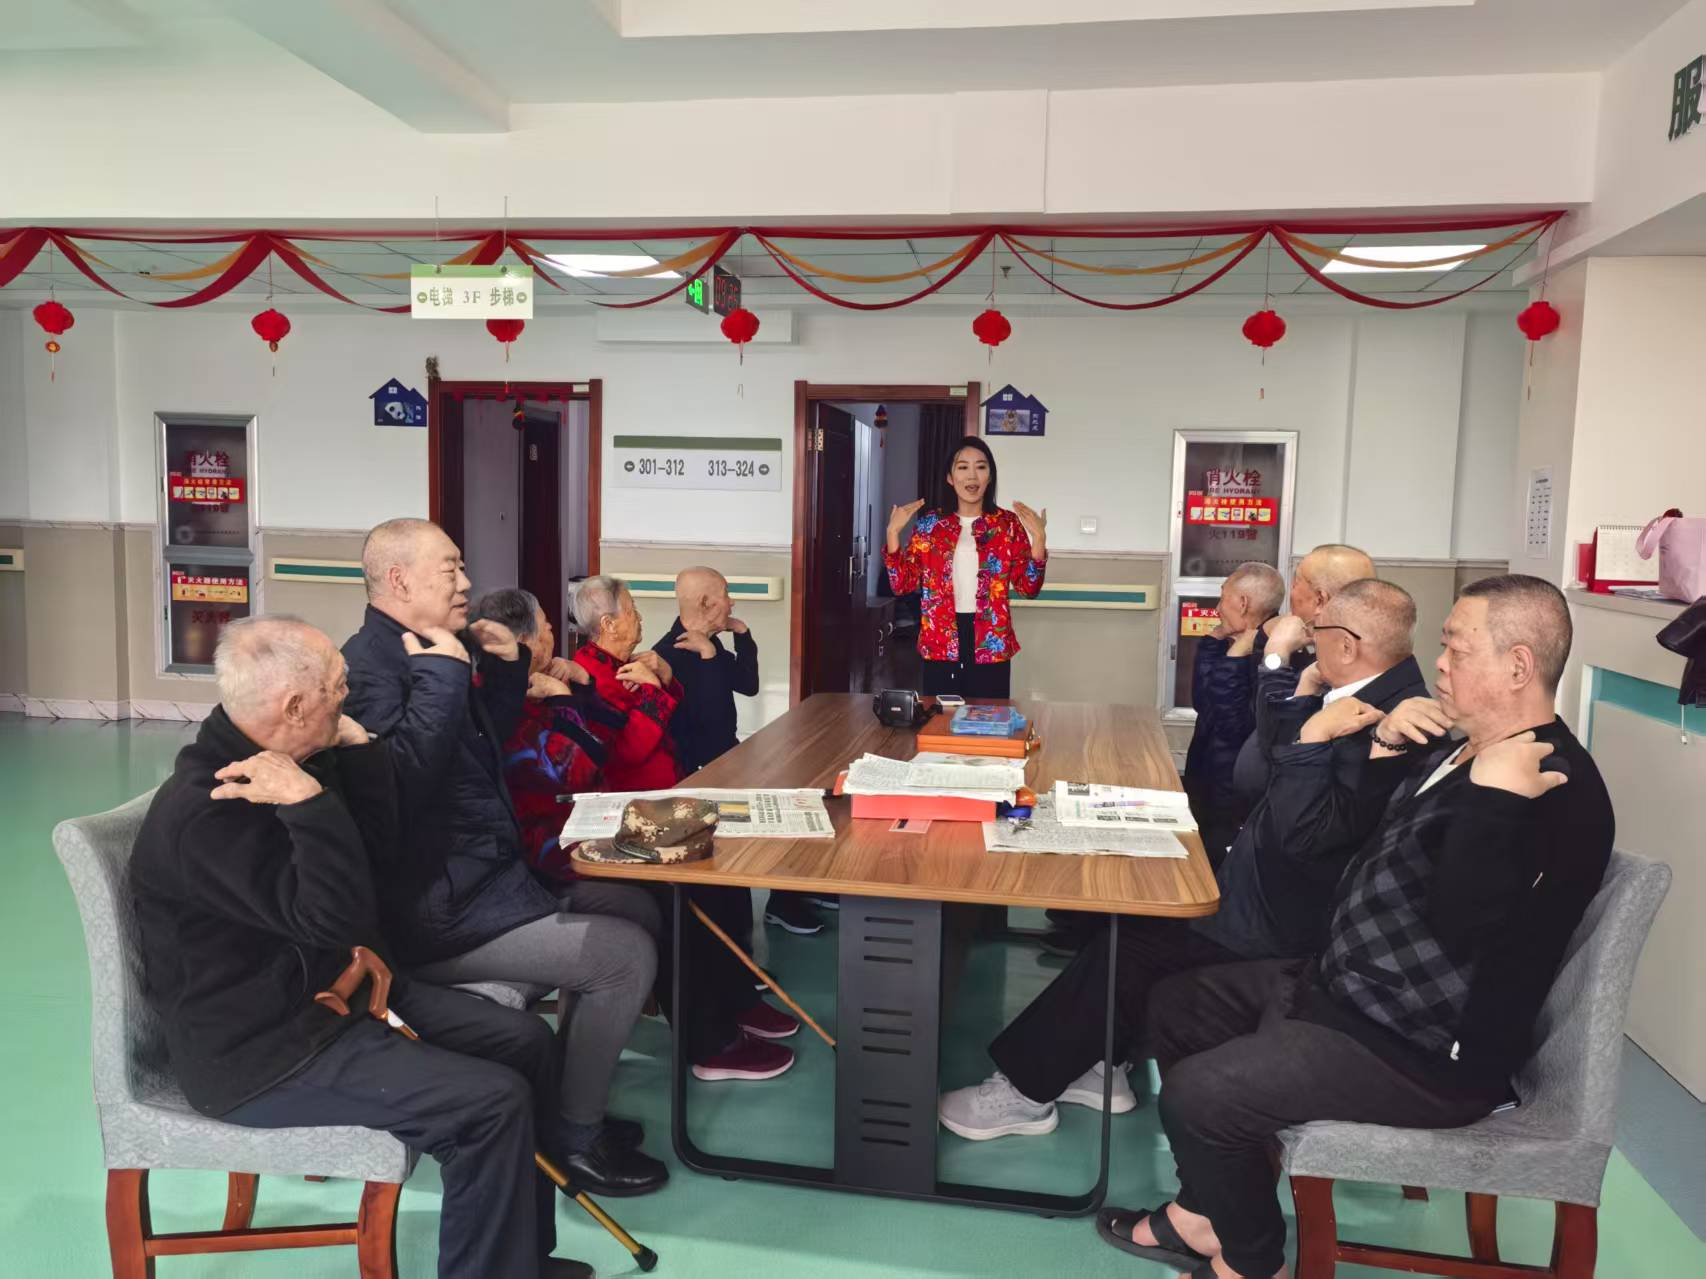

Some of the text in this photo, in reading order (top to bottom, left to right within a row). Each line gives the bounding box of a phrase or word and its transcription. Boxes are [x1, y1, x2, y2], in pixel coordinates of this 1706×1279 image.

[463, 290, 480, 304] 3F
[490, 287, 514, 306] 步梯
[638, 458, 755, 477] 301-312 313-324
[188, 577, 243, 586] 灭火器使用方法
